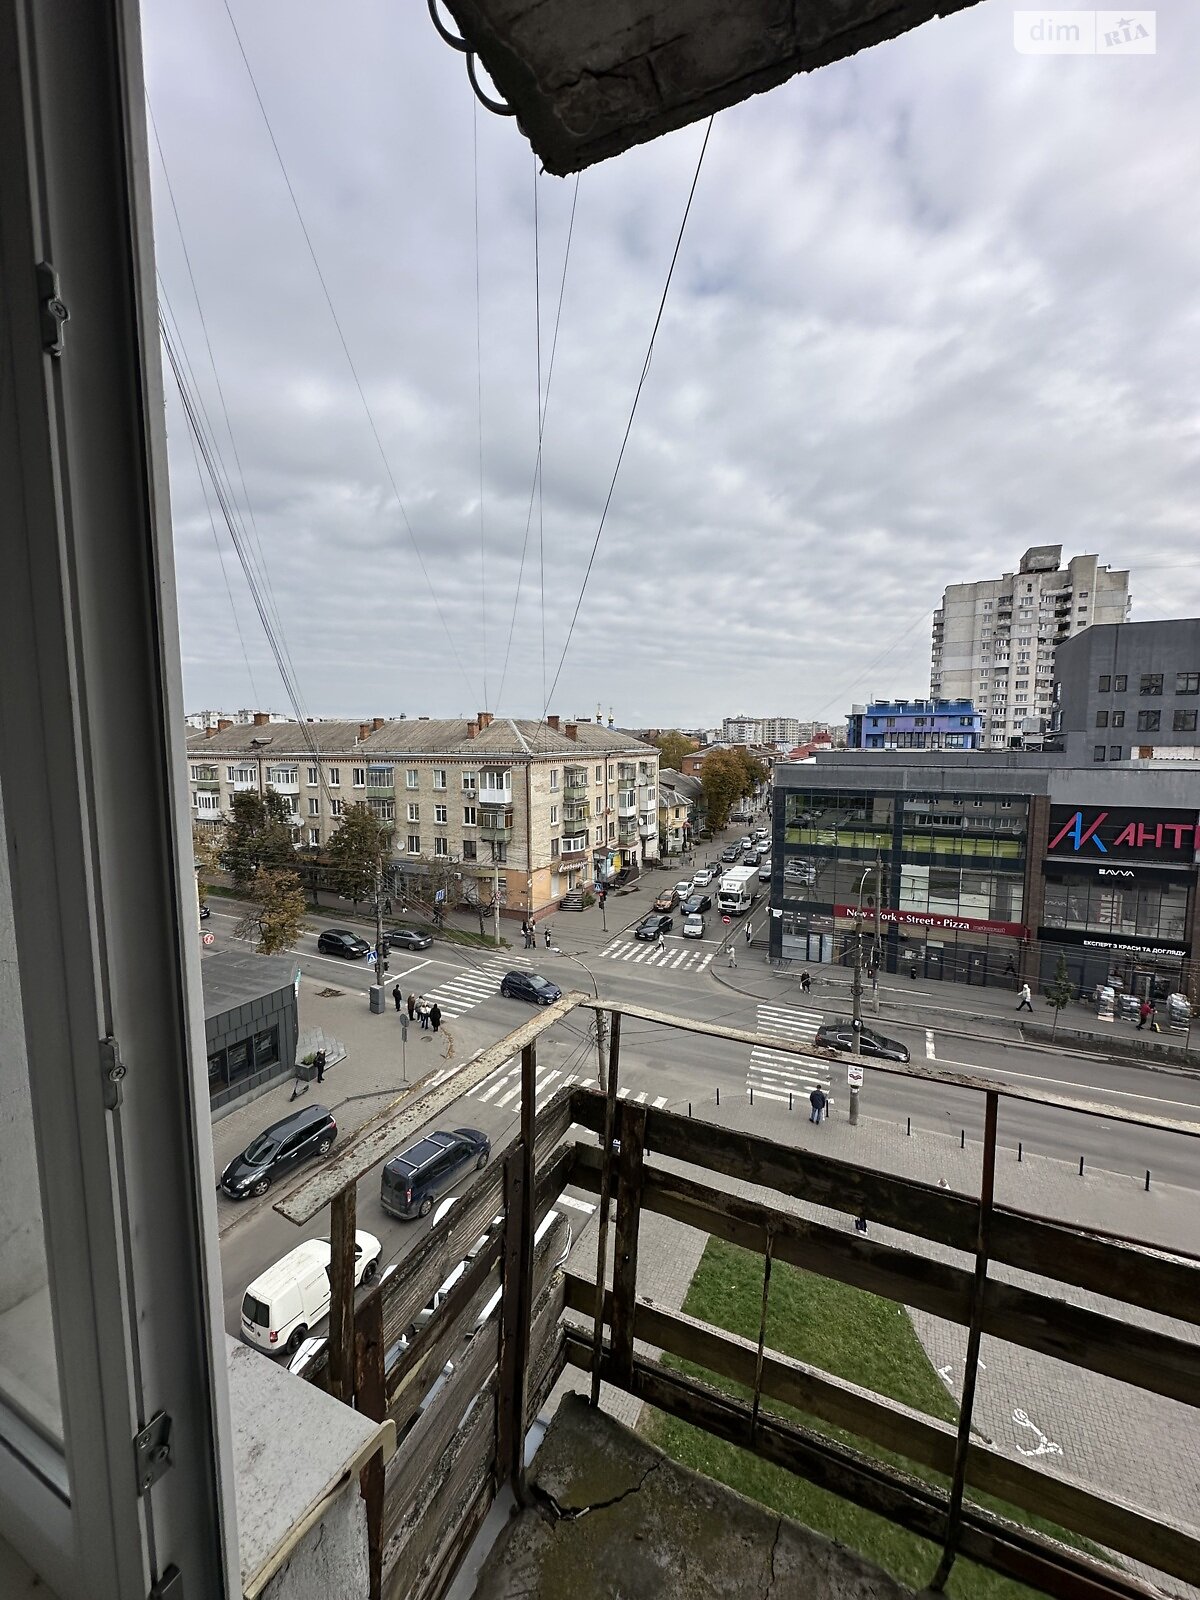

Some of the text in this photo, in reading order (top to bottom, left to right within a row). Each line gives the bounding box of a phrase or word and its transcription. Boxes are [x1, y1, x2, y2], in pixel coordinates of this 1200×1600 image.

[906, 914, 934, 926] Street
[943, 918, 970, 930] Pizza
[1083, 940, 1112, 949] ЕКСПЕРТ
[1118, 944, 1141, 952] КРАСИ
[1151, 948, 1186, 957] ДОГЛЯДУ
